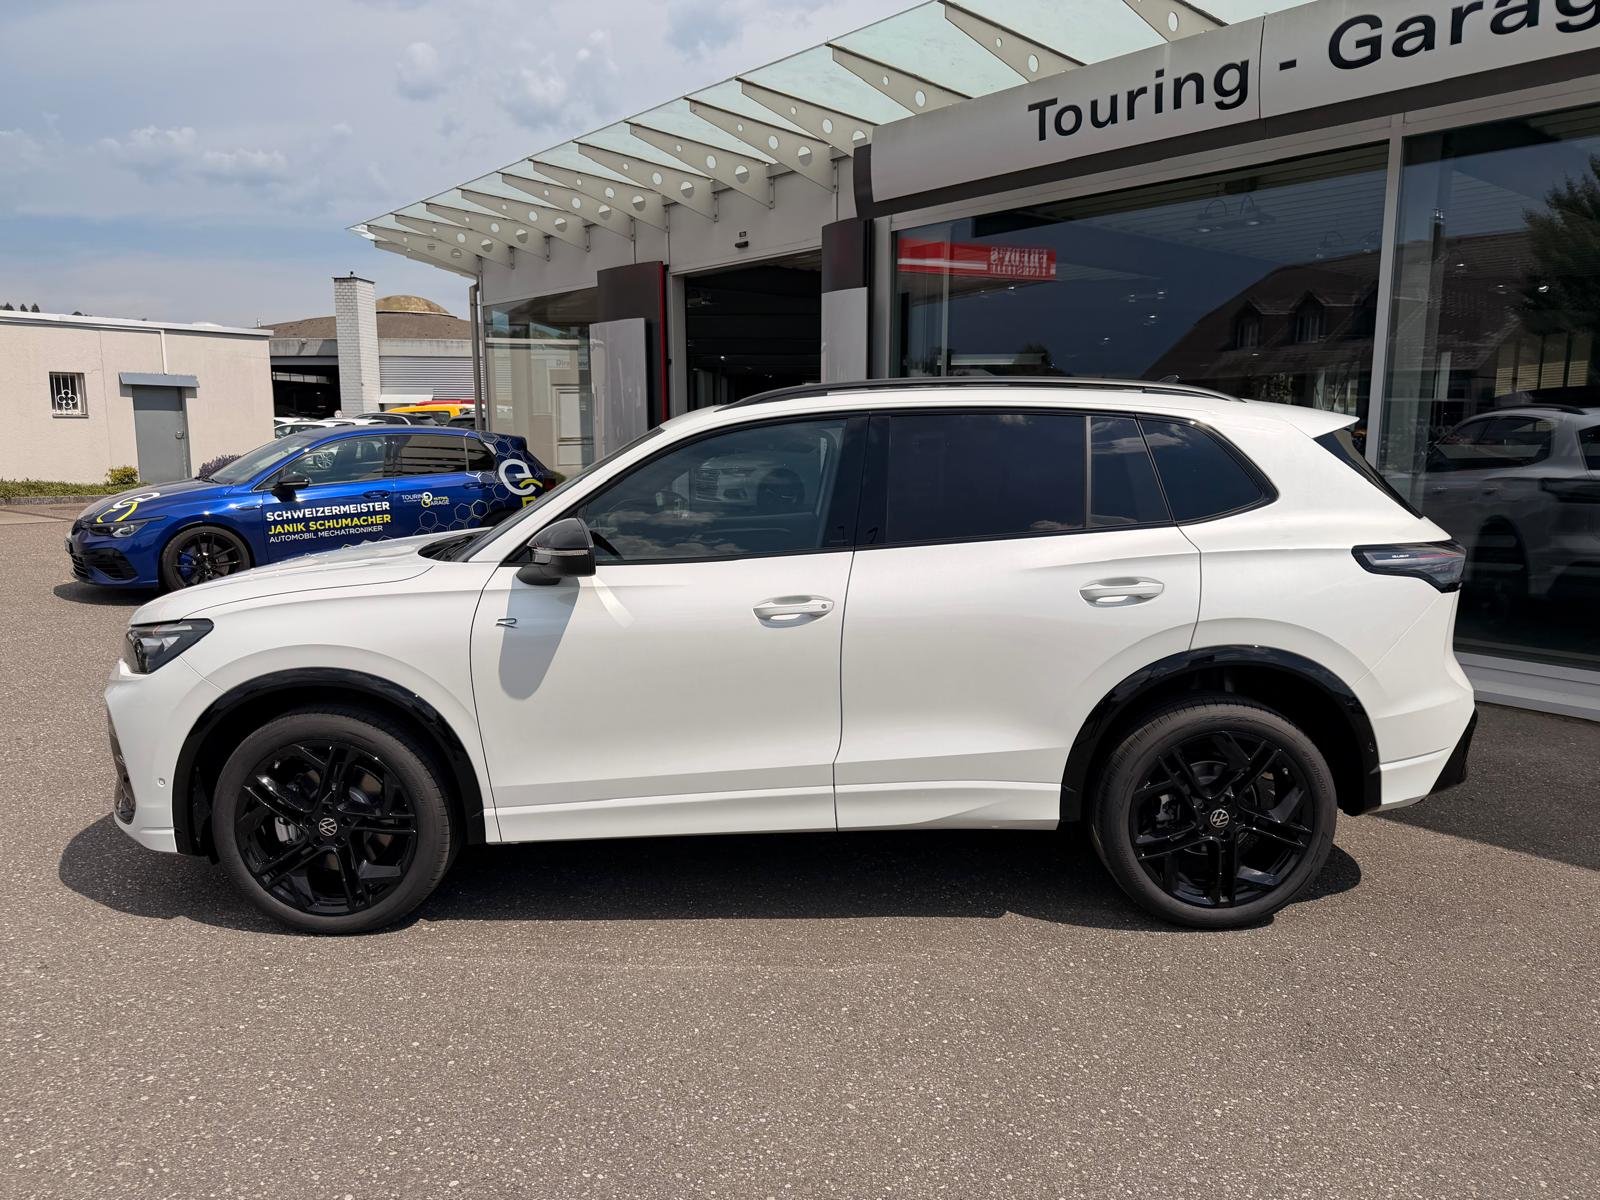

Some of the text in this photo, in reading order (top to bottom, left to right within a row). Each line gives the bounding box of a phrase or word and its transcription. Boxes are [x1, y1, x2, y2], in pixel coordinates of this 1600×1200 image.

[1028, 59, 1250, 142] Touring
[266, 501, 391, 521] SCHWEIZERMEISTER
[268, 514, 391, 535] JANIK SCHUMACHER
[269, 525, 384, 543] AUTOMOBIL MECHATRONIKER
